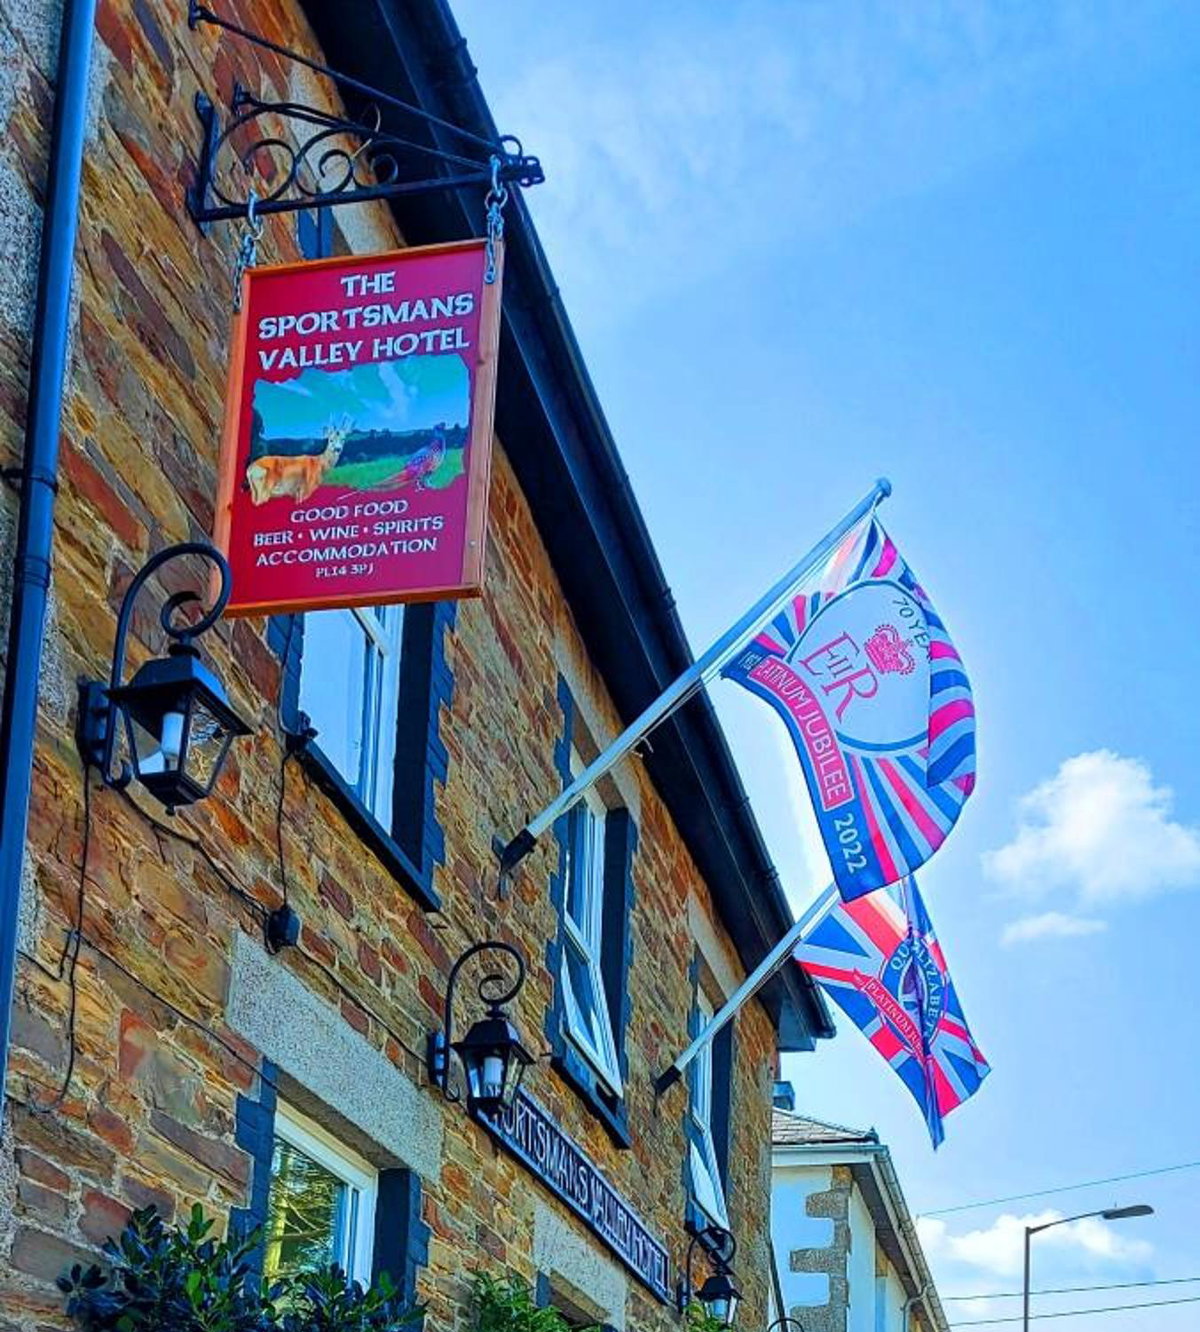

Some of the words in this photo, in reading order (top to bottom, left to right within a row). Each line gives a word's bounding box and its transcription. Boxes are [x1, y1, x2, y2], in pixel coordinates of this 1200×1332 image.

[341, 271, 395, 297] THE
[258, 292, 474, 340] SPORTSMANS
[258, 340, 364, 371] VALLEY
[372, 327, 470, 360] HOTEL
[291, 505, 349, 523] GOOD
[354, 499, 408, 518] FOOD
[253, 530, 293, 547] BEER
[309, 525, 360, 541] WINE
[373, 515, 444, 536] SPIRITS
[256, 537, 437, 567] ACCOMMODATION
[892, 597, 914, 618] 70
[799, 710, 847, 800] JUBILEE
[834, 813, 867, 874] 2022
